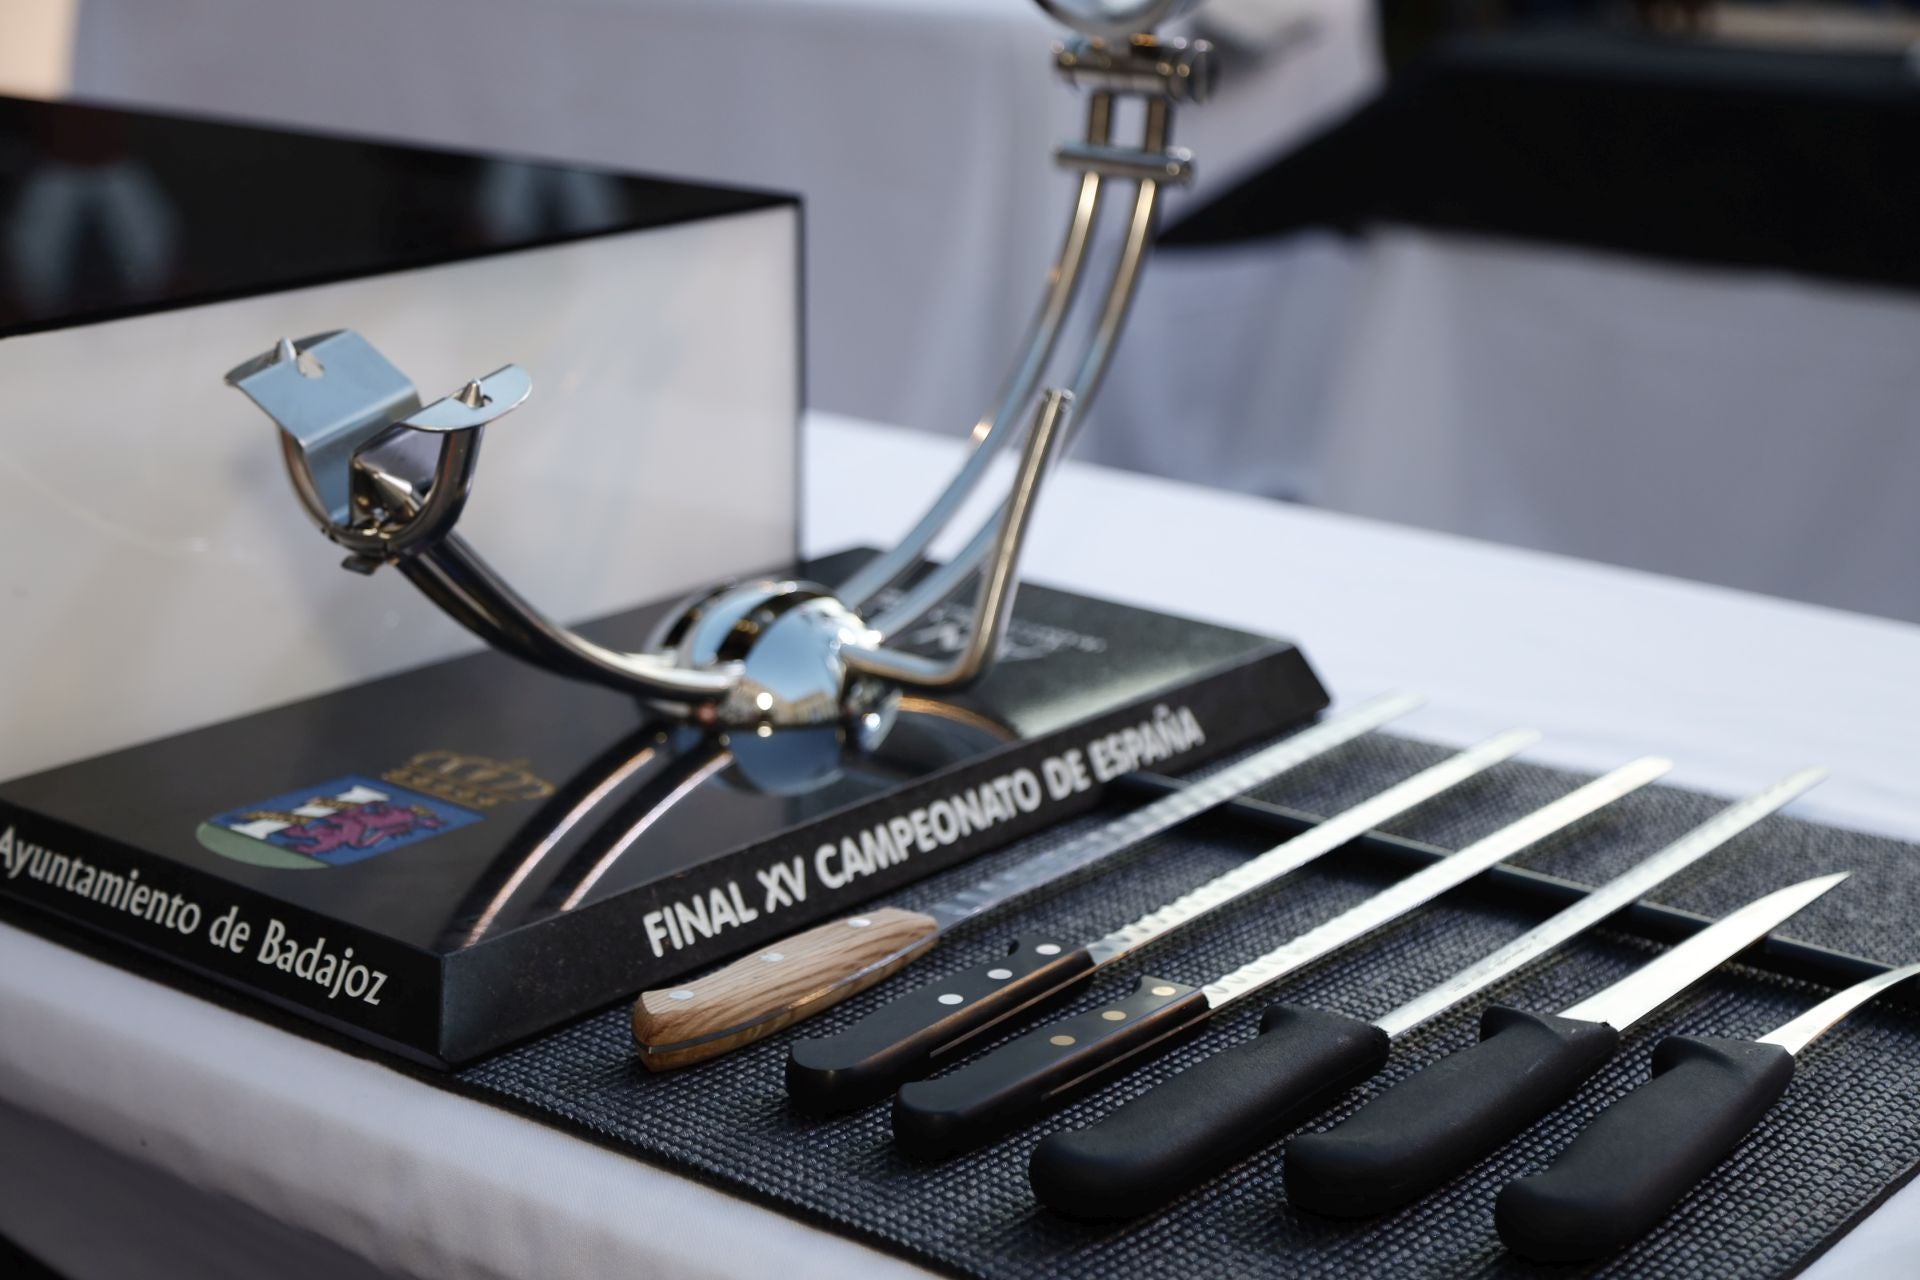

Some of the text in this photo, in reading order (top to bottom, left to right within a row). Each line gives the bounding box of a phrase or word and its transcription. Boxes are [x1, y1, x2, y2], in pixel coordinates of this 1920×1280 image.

[0, 825, 388, 1006] Ayuntamiento de Badajoz
[643, 704, 1204, 957] FINAL XV CAMPEONATO DE ESPAÑA
